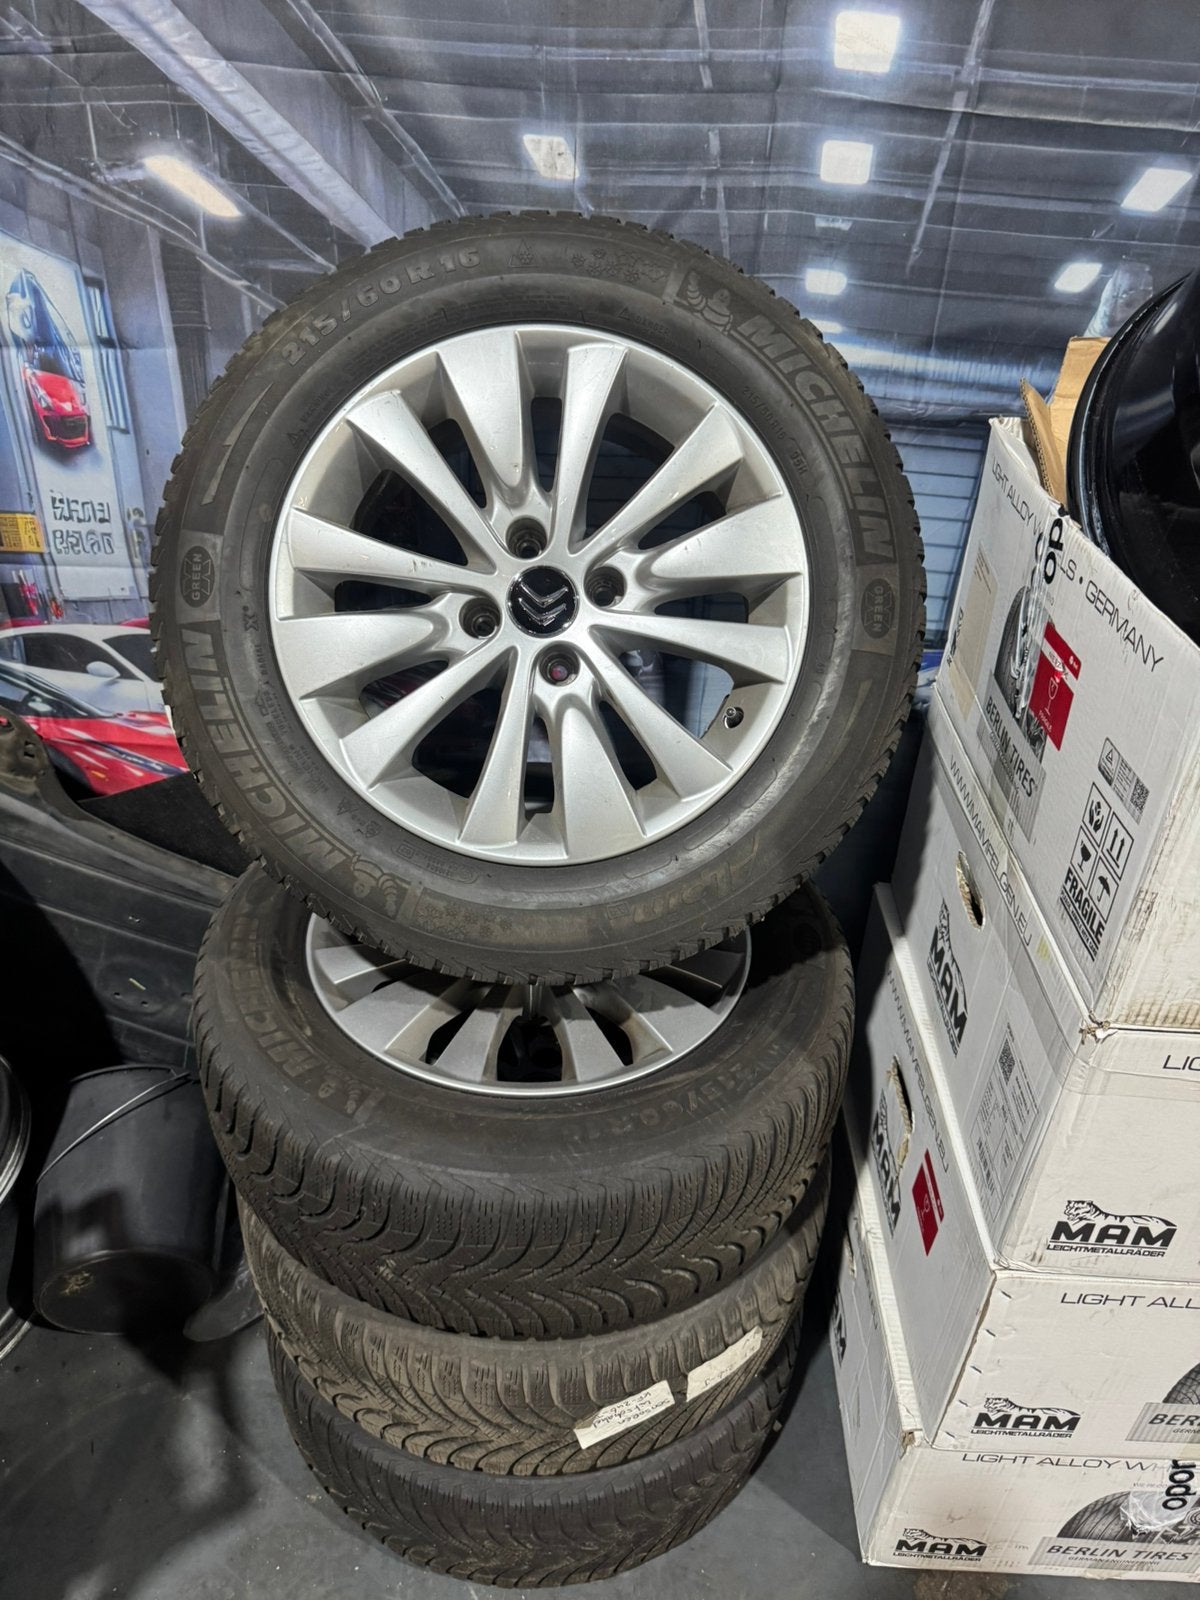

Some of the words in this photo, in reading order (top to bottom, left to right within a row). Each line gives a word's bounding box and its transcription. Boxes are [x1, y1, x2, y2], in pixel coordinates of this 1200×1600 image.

[737, 315, 896, 562] MICHELIN
[190, 552, 203, 600] GREEN
[1006, 485, 1035, 527] ALLOY
[1085, 580, 1164, 672] GERMANY
[871, 585, 883, 632] GREEN
[182, 629, 349, 873] MICHELIN
[985, 697, 1011, 753] BERLIN
[1009, 744, 1035, 797] TIRES
[1064, 867, 1105, 945] FRAGILE
[930, 925, 967, 1044] MAM
[1046, 1244, 1165, 1257] LEICHTMETALLRÄDER
[1050, 1221, 1177, 1247] MAM
[1060, 1292, 1146, 1306] LIGHT
[1147, 1296, 1200, 1310] ALL
[973, 1412, 1081, 1431] MAM
[1148, 1413, 1200, 1426] BER
[962, 1453, 1035, 1465] LIGHT
[1036, 1457, 1121, 1469] ALLOY
[895, 1539, 987, 1557] MAM
[1046, 1545, 1127, 1558] BERLIN
[1132, 1550, 1193, 1561] TIRES
